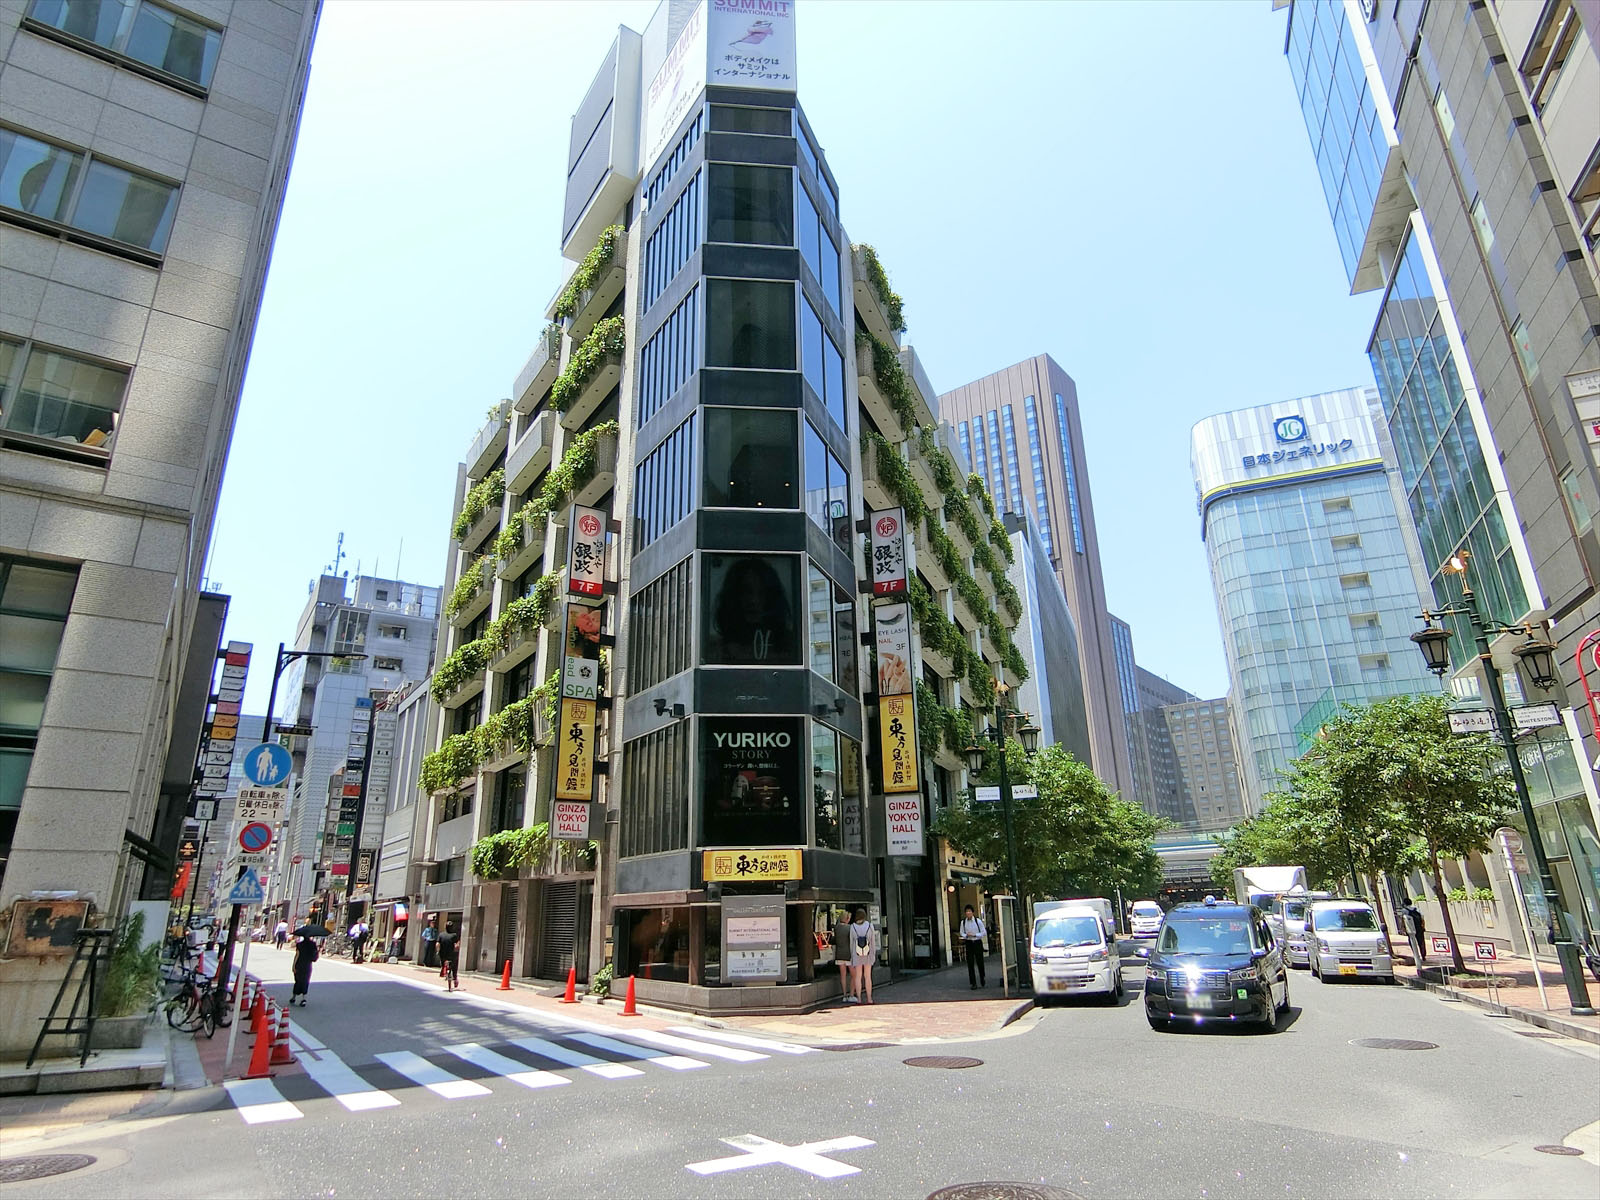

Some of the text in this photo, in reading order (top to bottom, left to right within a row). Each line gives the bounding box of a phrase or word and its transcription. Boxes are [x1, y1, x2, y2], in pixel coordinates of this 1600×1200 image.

[714, 7, 776, 17] INTERNATIONAL
[724, 54, 780, 65] ボディメイクは
[738, 63, 768, 71] サミット
[714, 68, 791, 80] インターナショナル
[1280, 420, 1300, 438] JG
[1242, 438, 1353, 469] 日本ジェネリック
[578, 581, 595, 592] 7F
[881, 581, 898, 592] 7F
[890, 627, 907, 635] LASH
[895, 643, 906, 651] 3F
[565, 684, 595, 698] SPA
[1519, 716, 1557, 724] WHITESTONE
[713, 732, 791, 748] YURIKO
[732, 749, 772, 759] STORY
[240, 789, 286, 799] 自転車を除く
[557, 804, 586, 813] GINZA
[888, 801, 918, 811] GINZA
[556, 813, 587, 823] YOKYO
[888, 813, 920, 822] YOKYO
[559, 823, 582, 832] HALL
[892, 824, 916, 833] HALL
